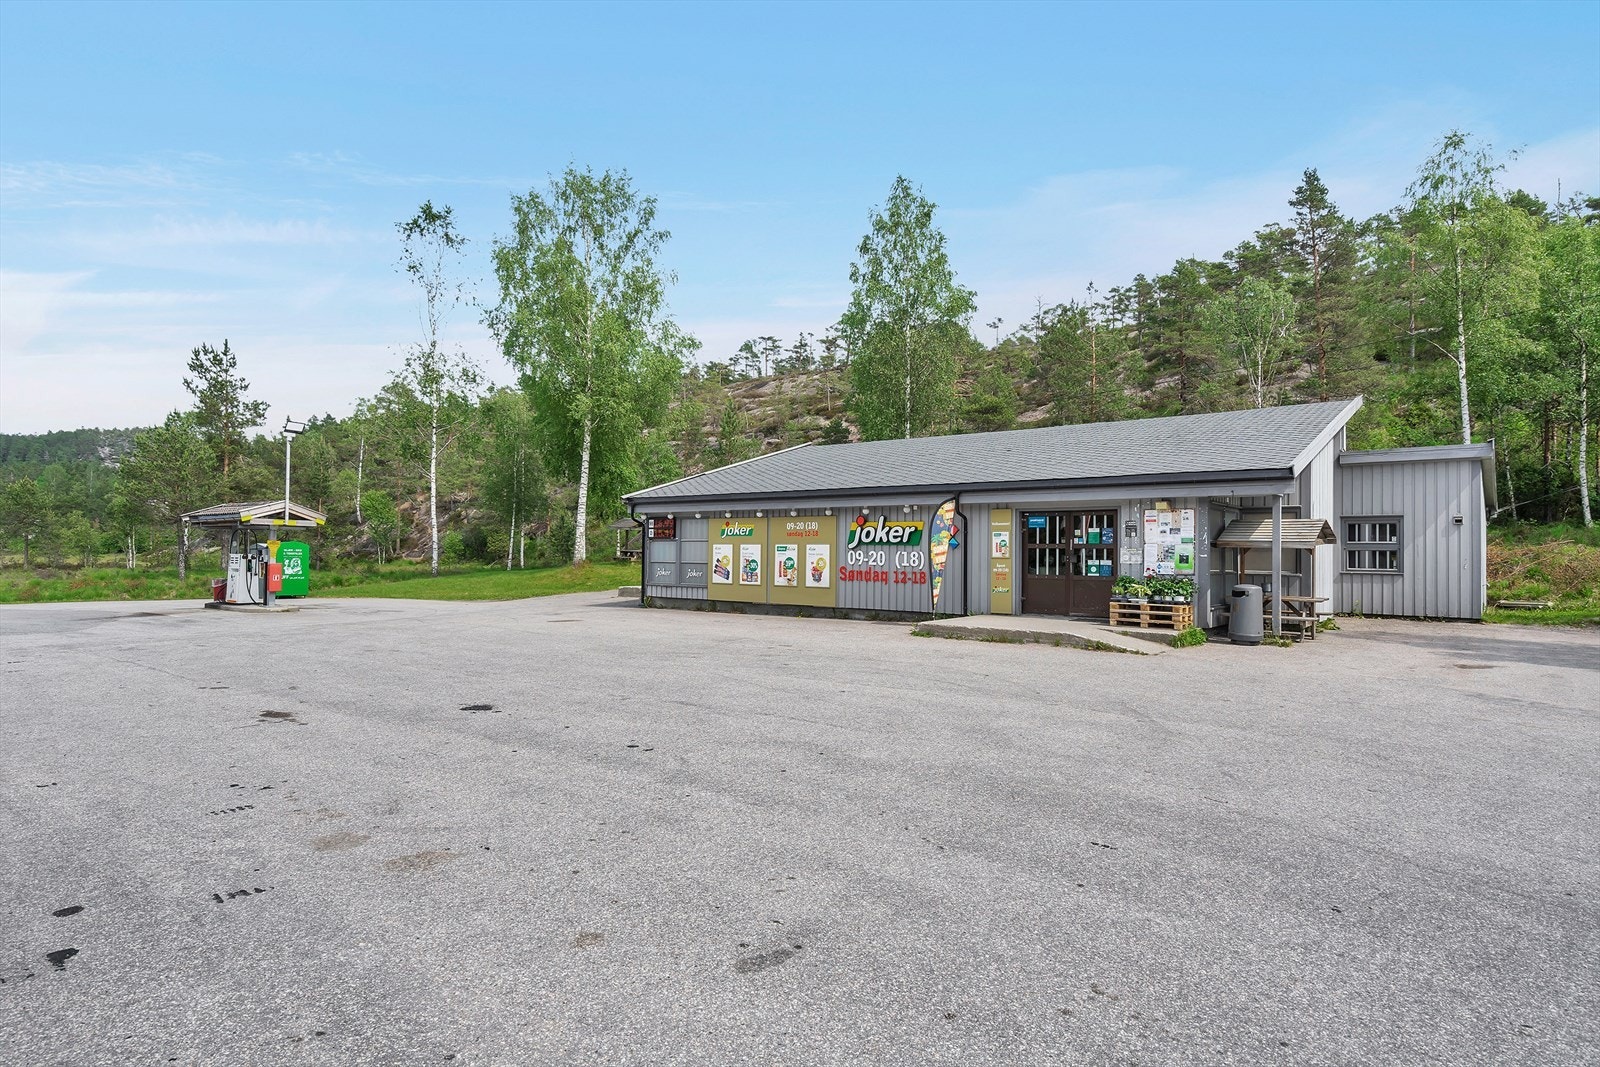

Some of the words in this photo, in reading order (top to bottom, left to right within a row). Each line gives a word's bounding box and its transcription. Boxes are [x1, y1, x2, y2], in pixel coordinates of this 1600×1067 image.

[721, 521, 752, 538] joker
[786, 522, 804, 530] 09-20
[805, 522, 819, 530] (18)
[848, 515, 916, 549] joker
[847, 551, 885, 566] 09-20
[895, 551, 925, 569] (18)
[655, 568, 671, 577] joker
[686, 568, 703, 578] joker
[839, 566, 888, 585] Søndag
[893, 571, 927, 584] 12-18
